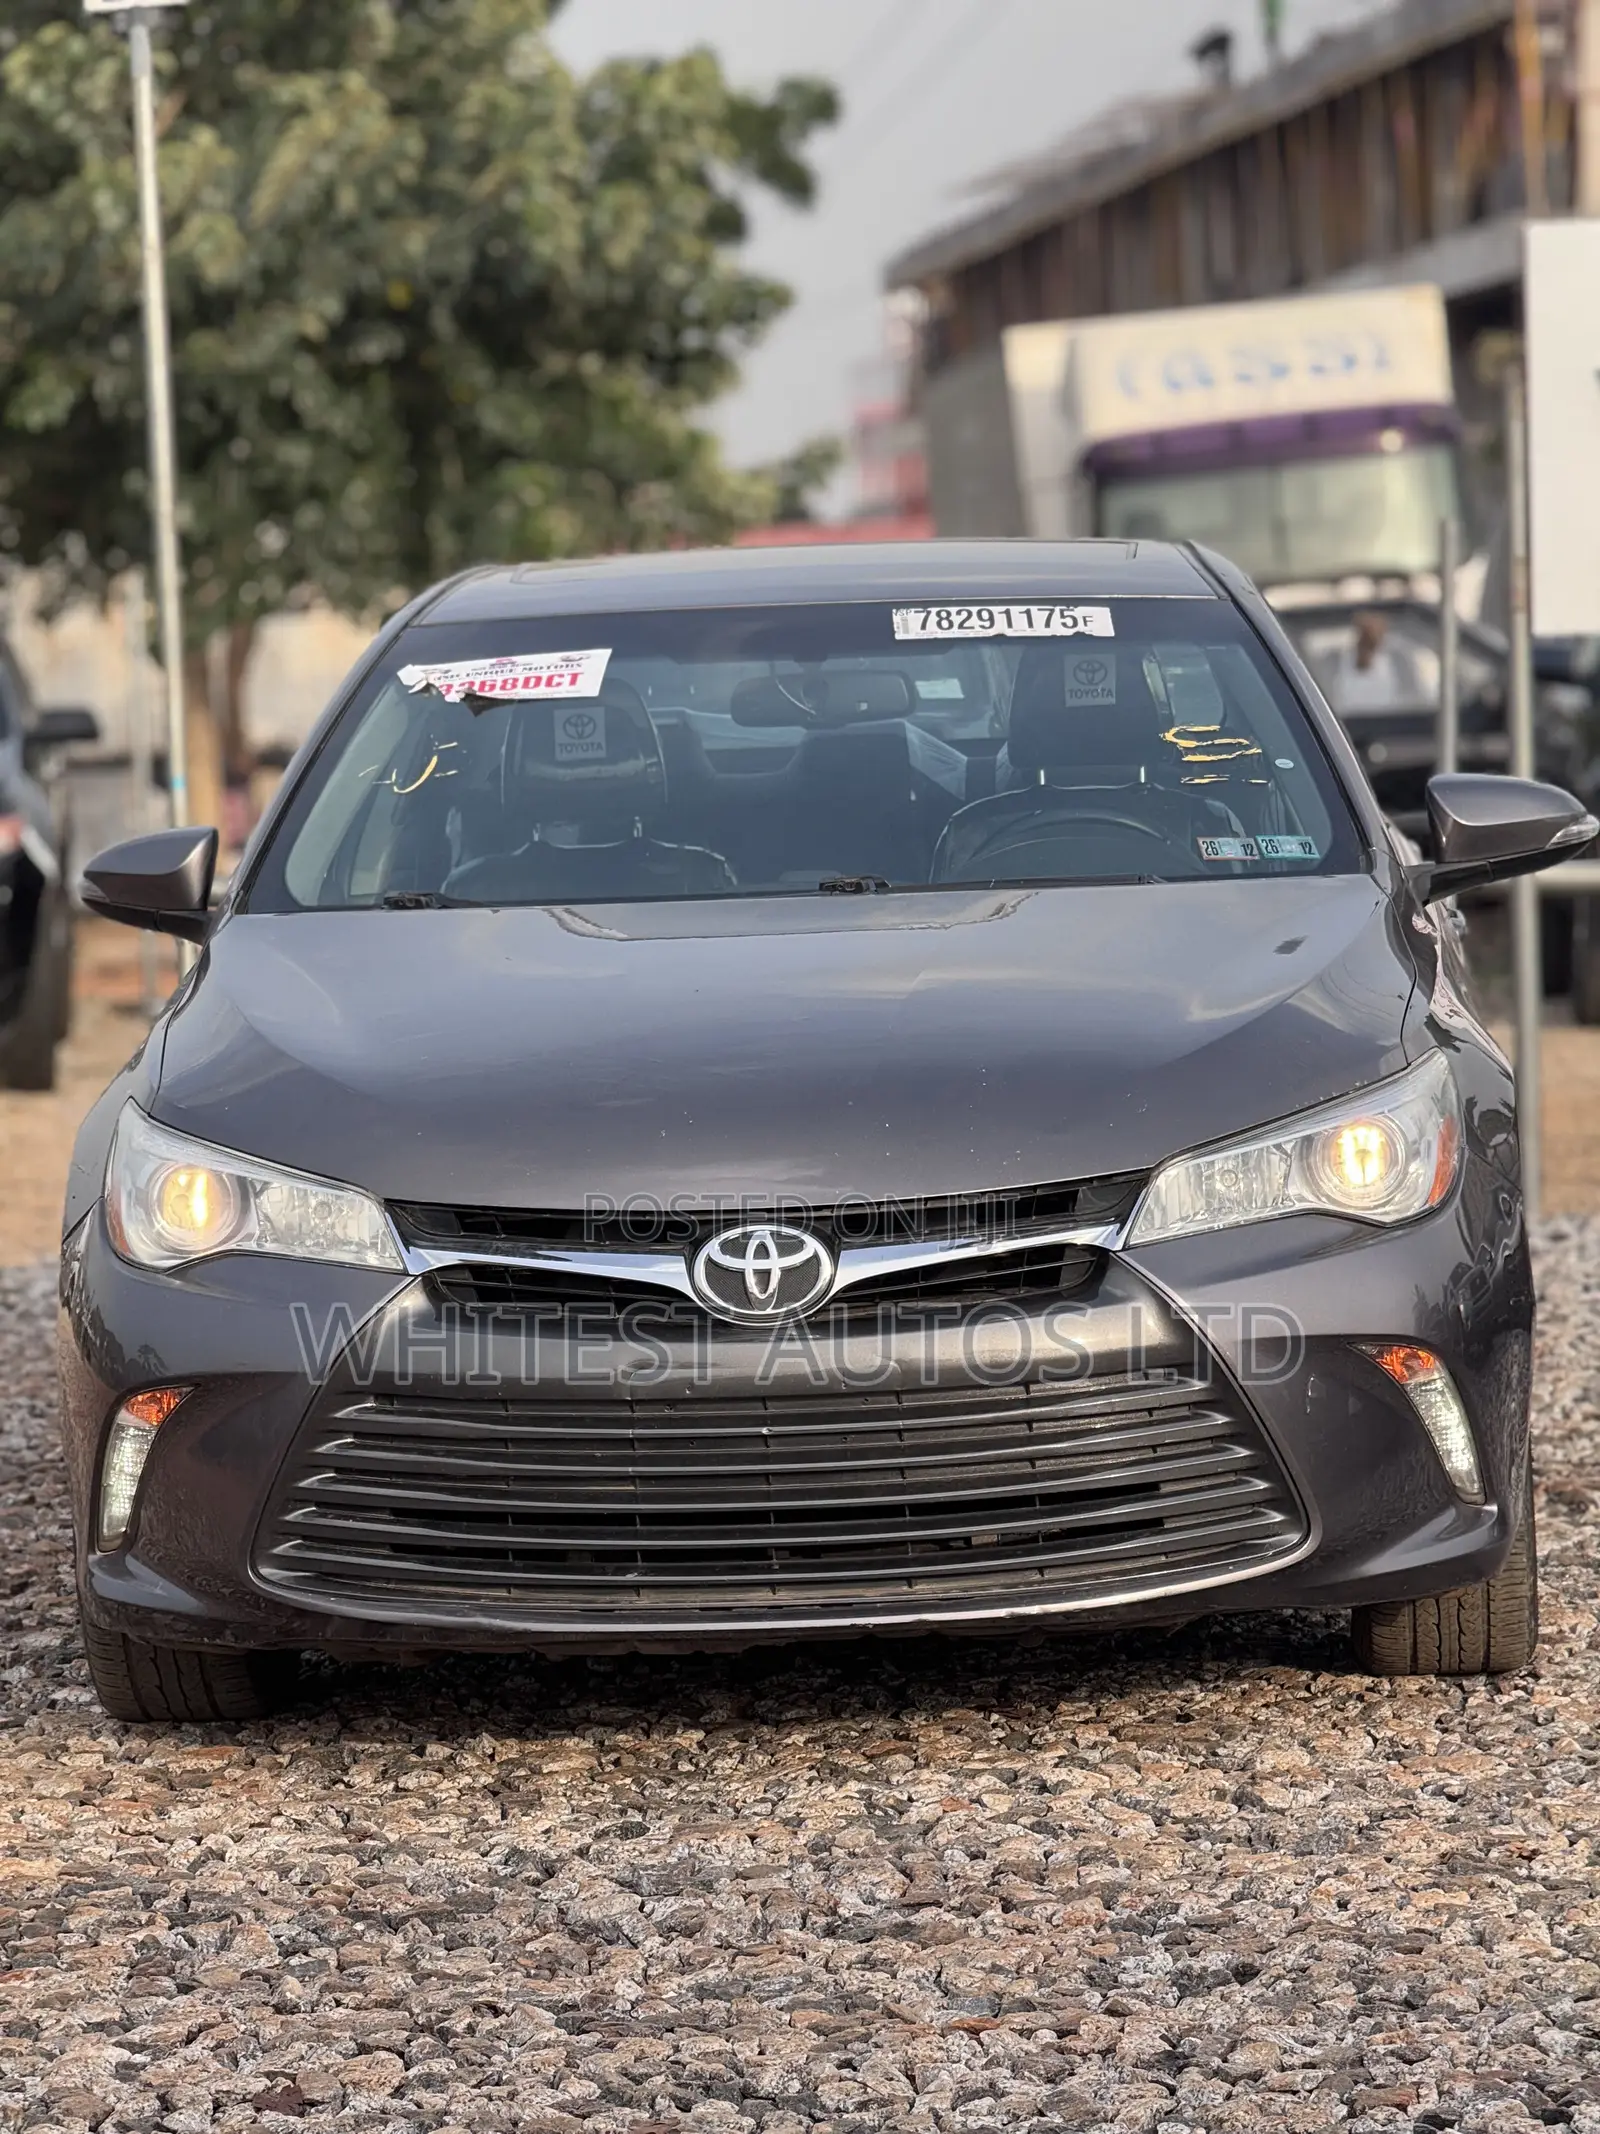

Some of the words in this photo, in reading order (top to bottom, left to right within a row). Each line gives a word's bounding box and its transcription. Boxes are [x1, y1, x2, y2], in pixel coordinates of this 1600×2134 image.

[914, 607, 1078, 631] 78291175
[1082, 615, 1094, 627] F
[1067, 687, 1114, 700] TOYOTA
[557, 741, 604, 755] TOYOTA
[1202, 840, 1219, 856] 26
[1241, 843, 1258, 857] 12
[1261, 838, 1279, 855] 26
[1299, 841, 1315, 856] 12
